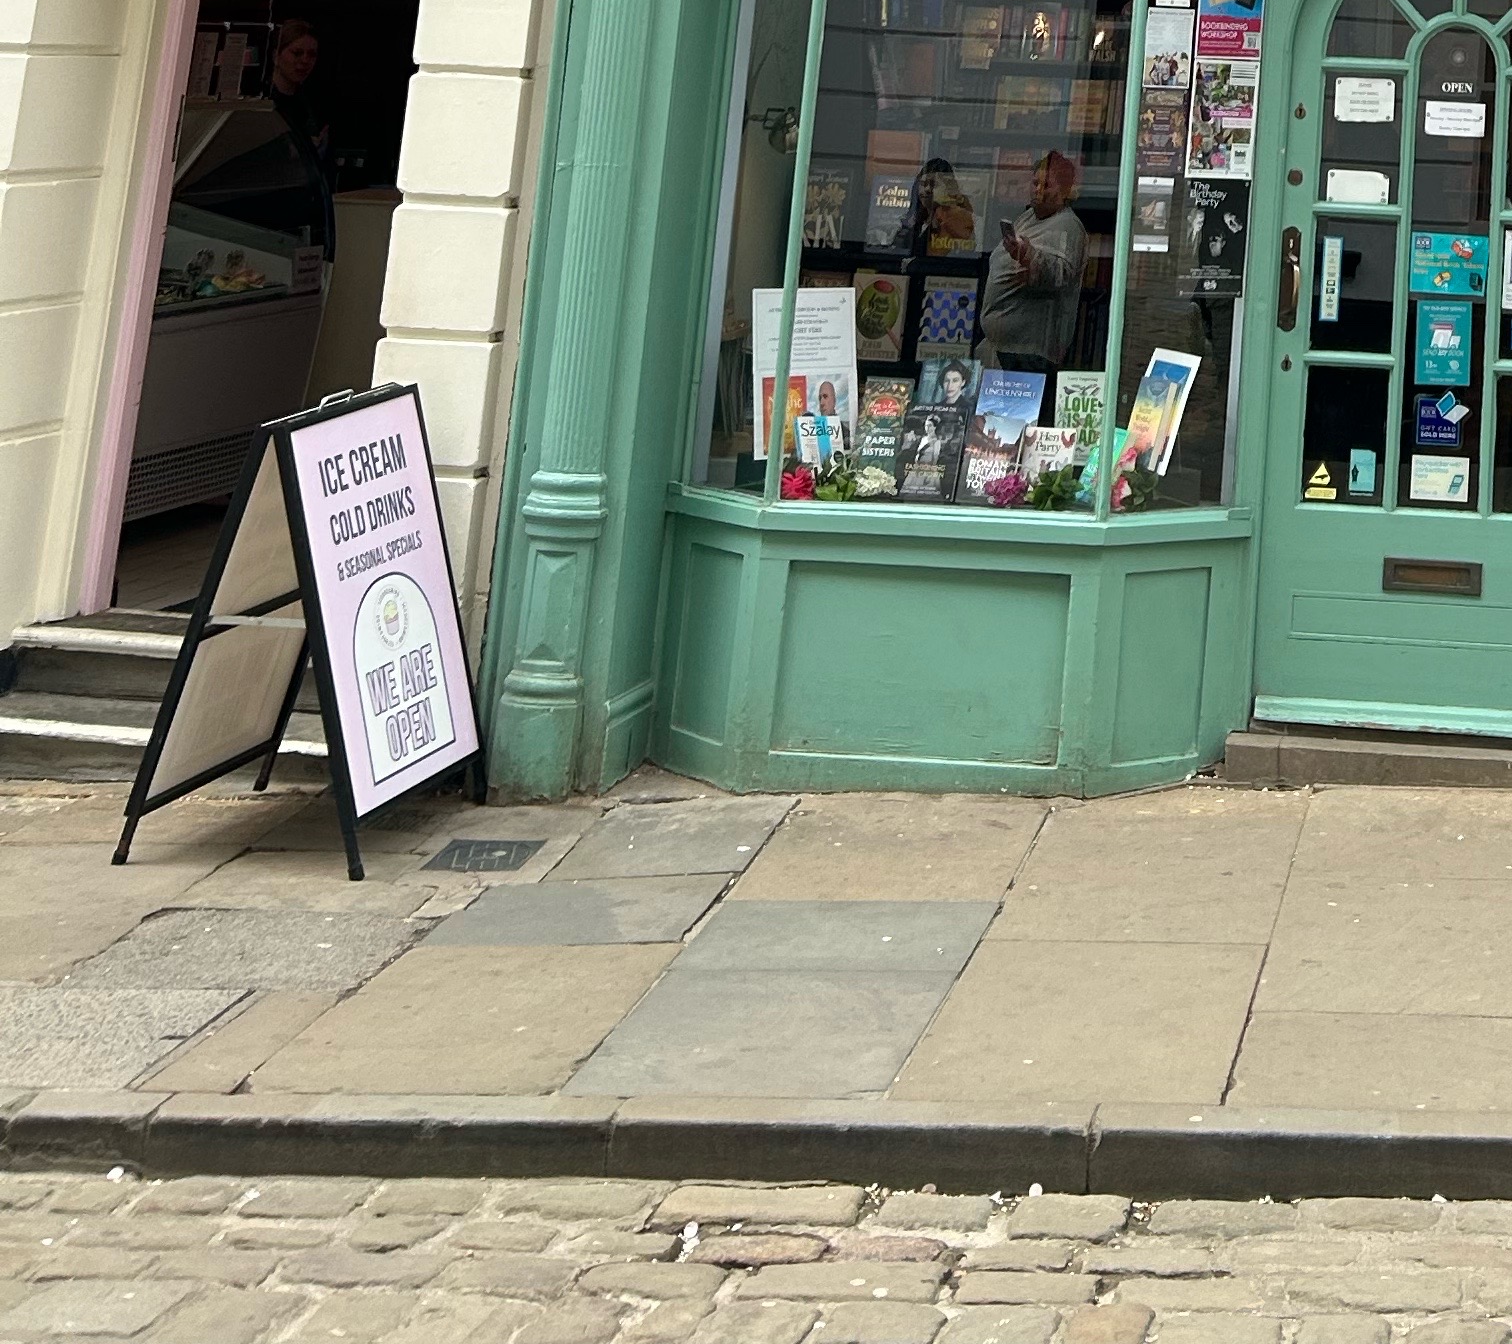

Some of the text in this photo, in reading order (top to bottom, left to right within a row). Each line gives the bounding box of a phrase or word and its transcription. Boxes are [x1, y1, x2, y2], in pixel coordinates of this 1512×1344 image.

[1441, 81, 1474, 94] OPEN
[1193, 181, 1210, 191] The
[1189, 189, 1228, 201] Birthday
[1195, 197, 1220, 209] Party
[1064, 395, 1099, 413] LOVE
[800, 421, 841, 440] Szalay
[1039, 431, 1060, 442] Hen
[865, 435, 896, 446] PAPER
[861, 447, 895, 458] SISTERS
[318, 433, 407, 497] ICE CREAM
[968, 457, 1008, 469] ROMAN
[330, 486, 416, 546] COLD DRINKS
[337, 530, 423, 581] & SEASONAL SPECIALS
[366, 643, 437, 717] WE ARE
[386, 697, 437, 762] OPEN
